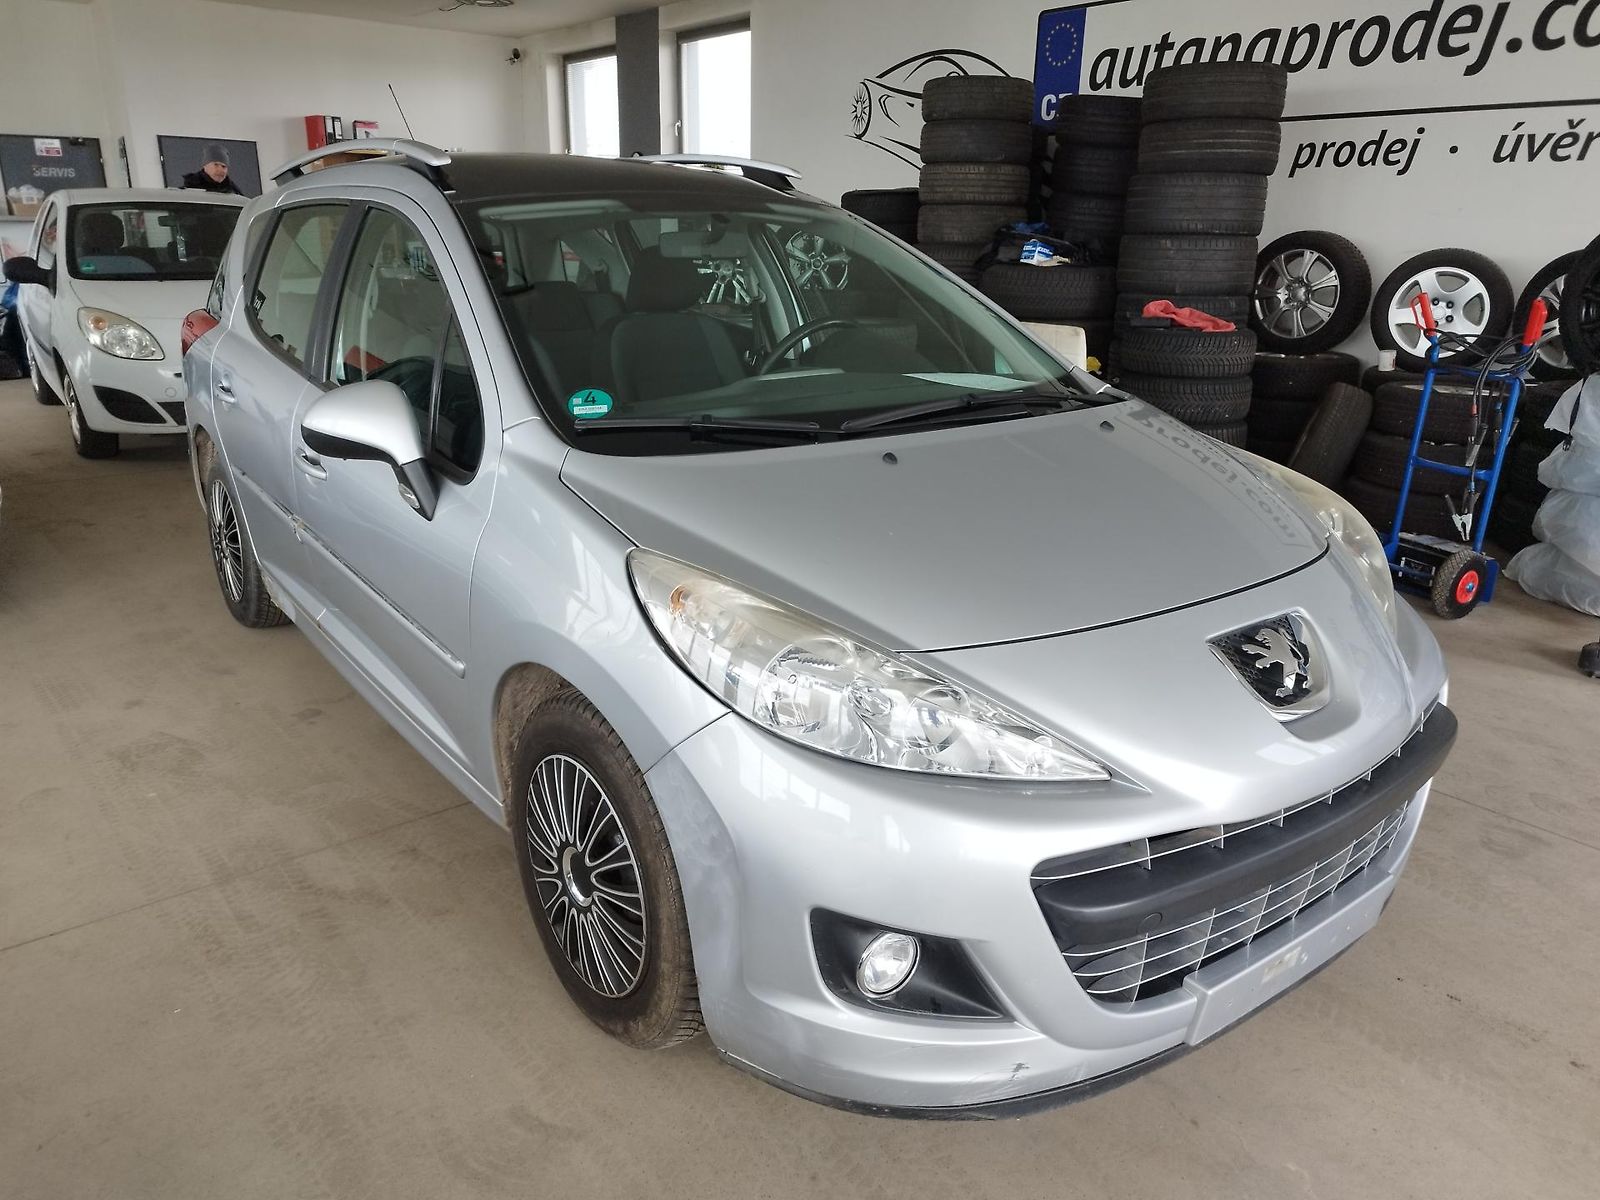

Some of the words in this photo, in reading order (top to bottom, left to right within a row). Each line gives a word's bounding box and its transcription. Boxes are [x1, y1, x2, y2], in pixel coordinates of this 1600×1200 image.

[1041, 93, 1073, 121] C
[1288, 126, 1426, 177] prodej
[33, 167, 76, 177] SERVIS
[584, 391, 597, 404] 4
